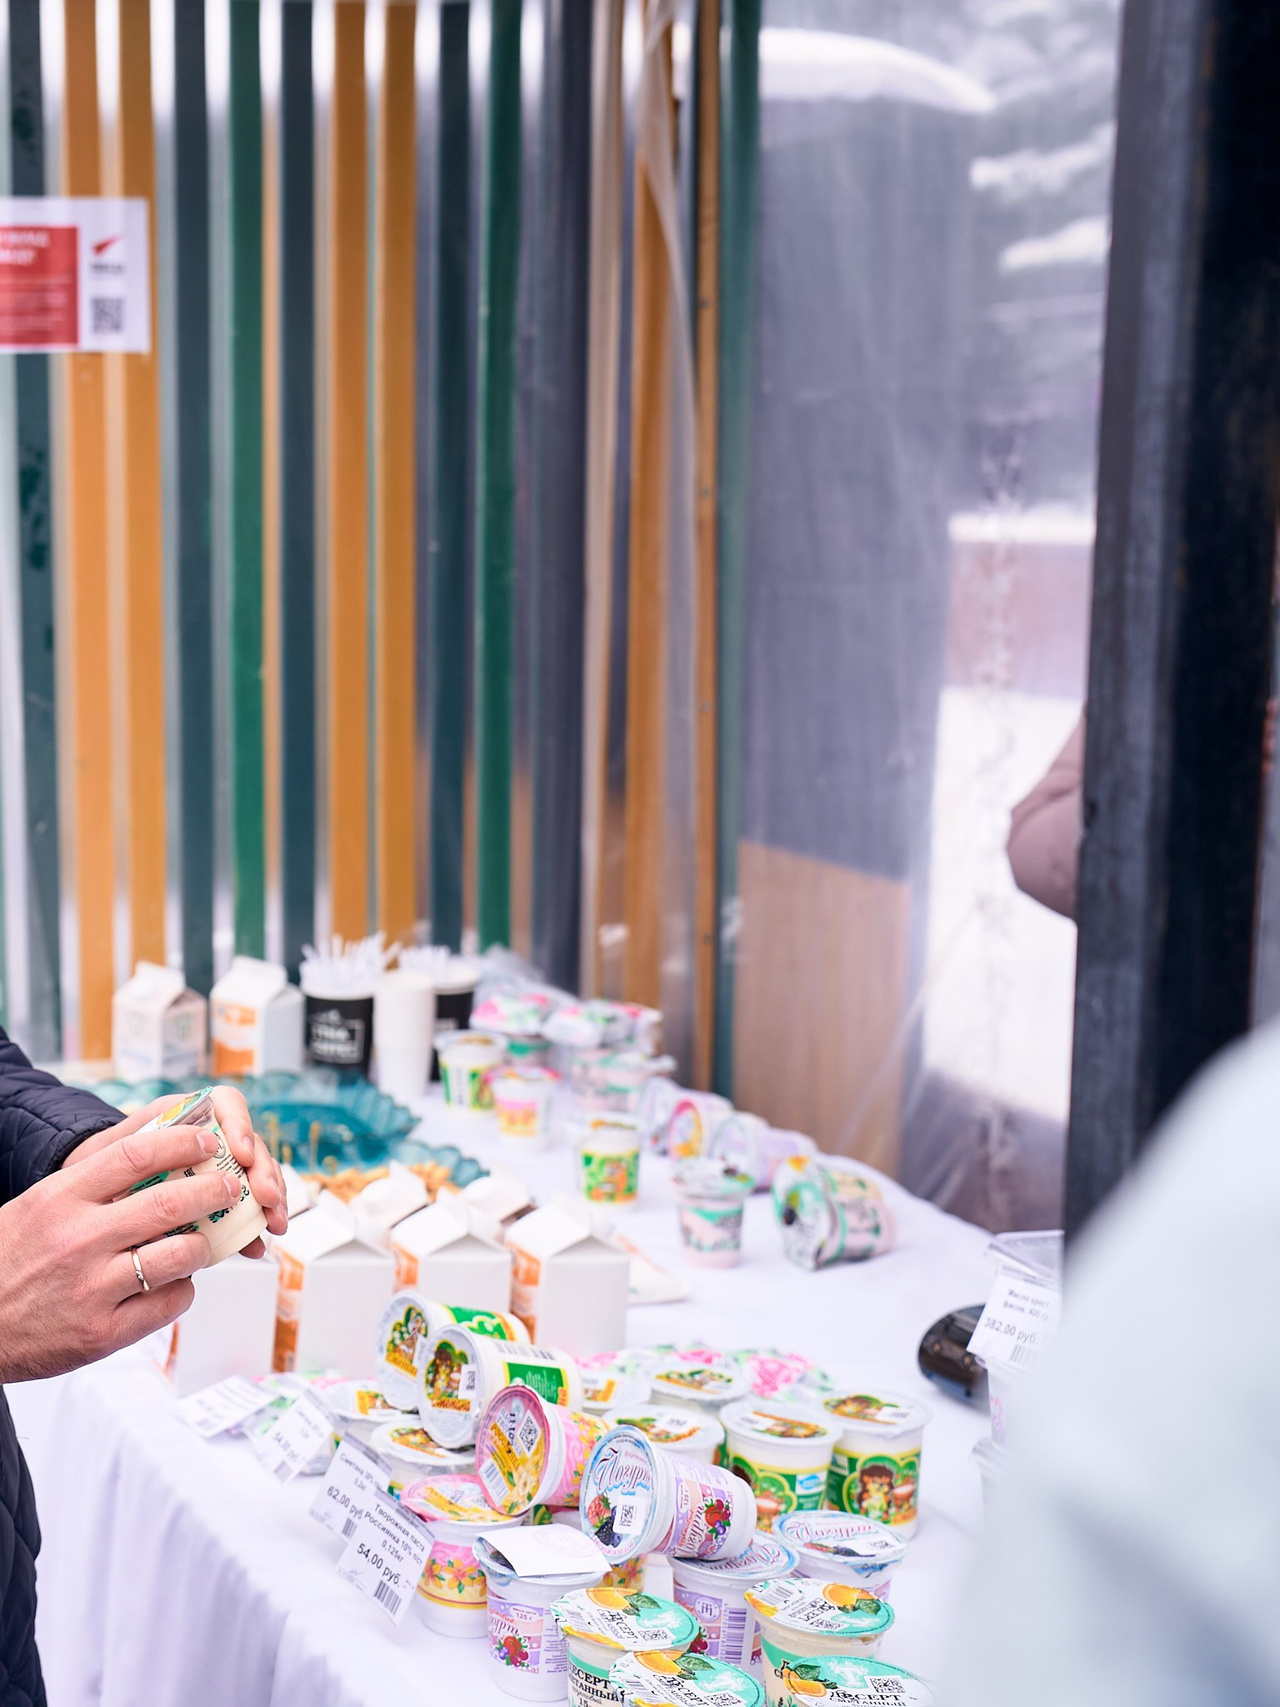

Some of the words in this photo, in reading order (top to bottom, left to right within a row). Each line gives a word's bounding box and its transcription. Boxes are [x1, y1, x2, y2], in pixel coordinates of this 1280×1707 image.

[593, 1446, 652, 1492] Йогурт
[326, 1485, 351, 1509] 62,00
[363, 1511, 401, 1545] Россиянка
[400, 1539, 413, 1557] 10%
[374, 1502, 410, 1538] Творожная
[409, 1534, 426, 1553] паста
[381, 1538, 404, 1563] 0,125кг
[356, 1542, 383, 1570] 54,00
[382, 1565, 401, 1589] руб.
[516, 1612, 528, 1621] 125
